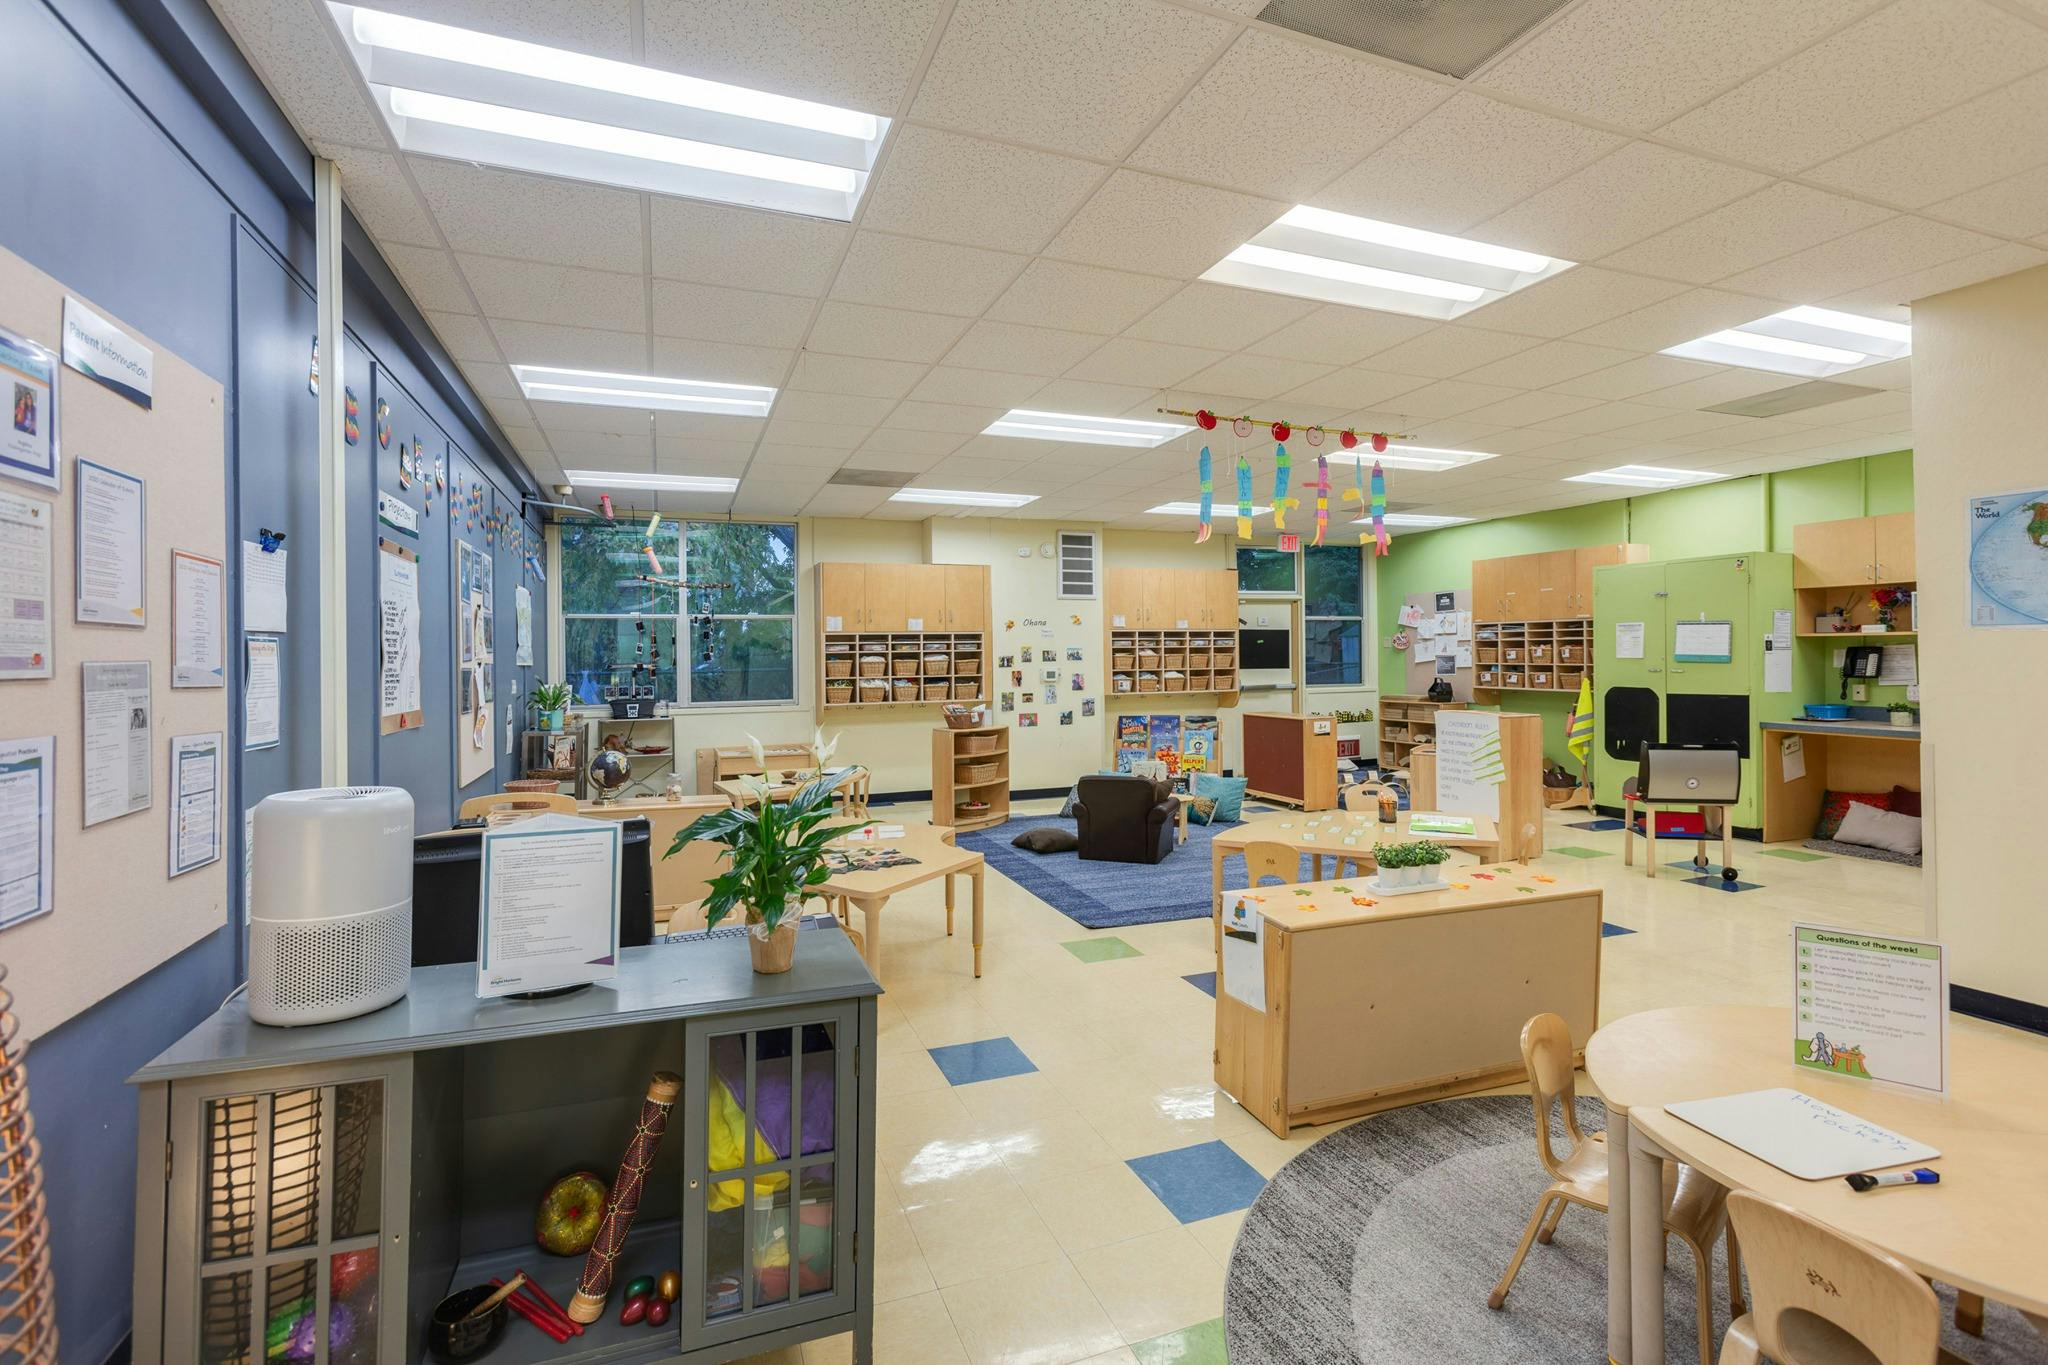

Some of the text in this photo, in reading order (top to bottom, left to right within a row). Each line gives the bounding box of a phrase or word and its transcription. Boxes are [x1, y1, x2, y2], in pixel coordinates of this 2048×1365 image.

[69, 320, 148, 380] Parent Information
[1975, 511, 2000, 519] World
[1281, 535, 1297, 551] EXIT
[1023, 618, 1047, 627] Ohana
[1816, 934, 1860, 946] Questions
[1872, 942, 1887, 950] the
[1889, 945, 1918, 954] week!
[1791, 1094, 1842, 1117] How
[1812, 1113, 1881, 1143] rocks
